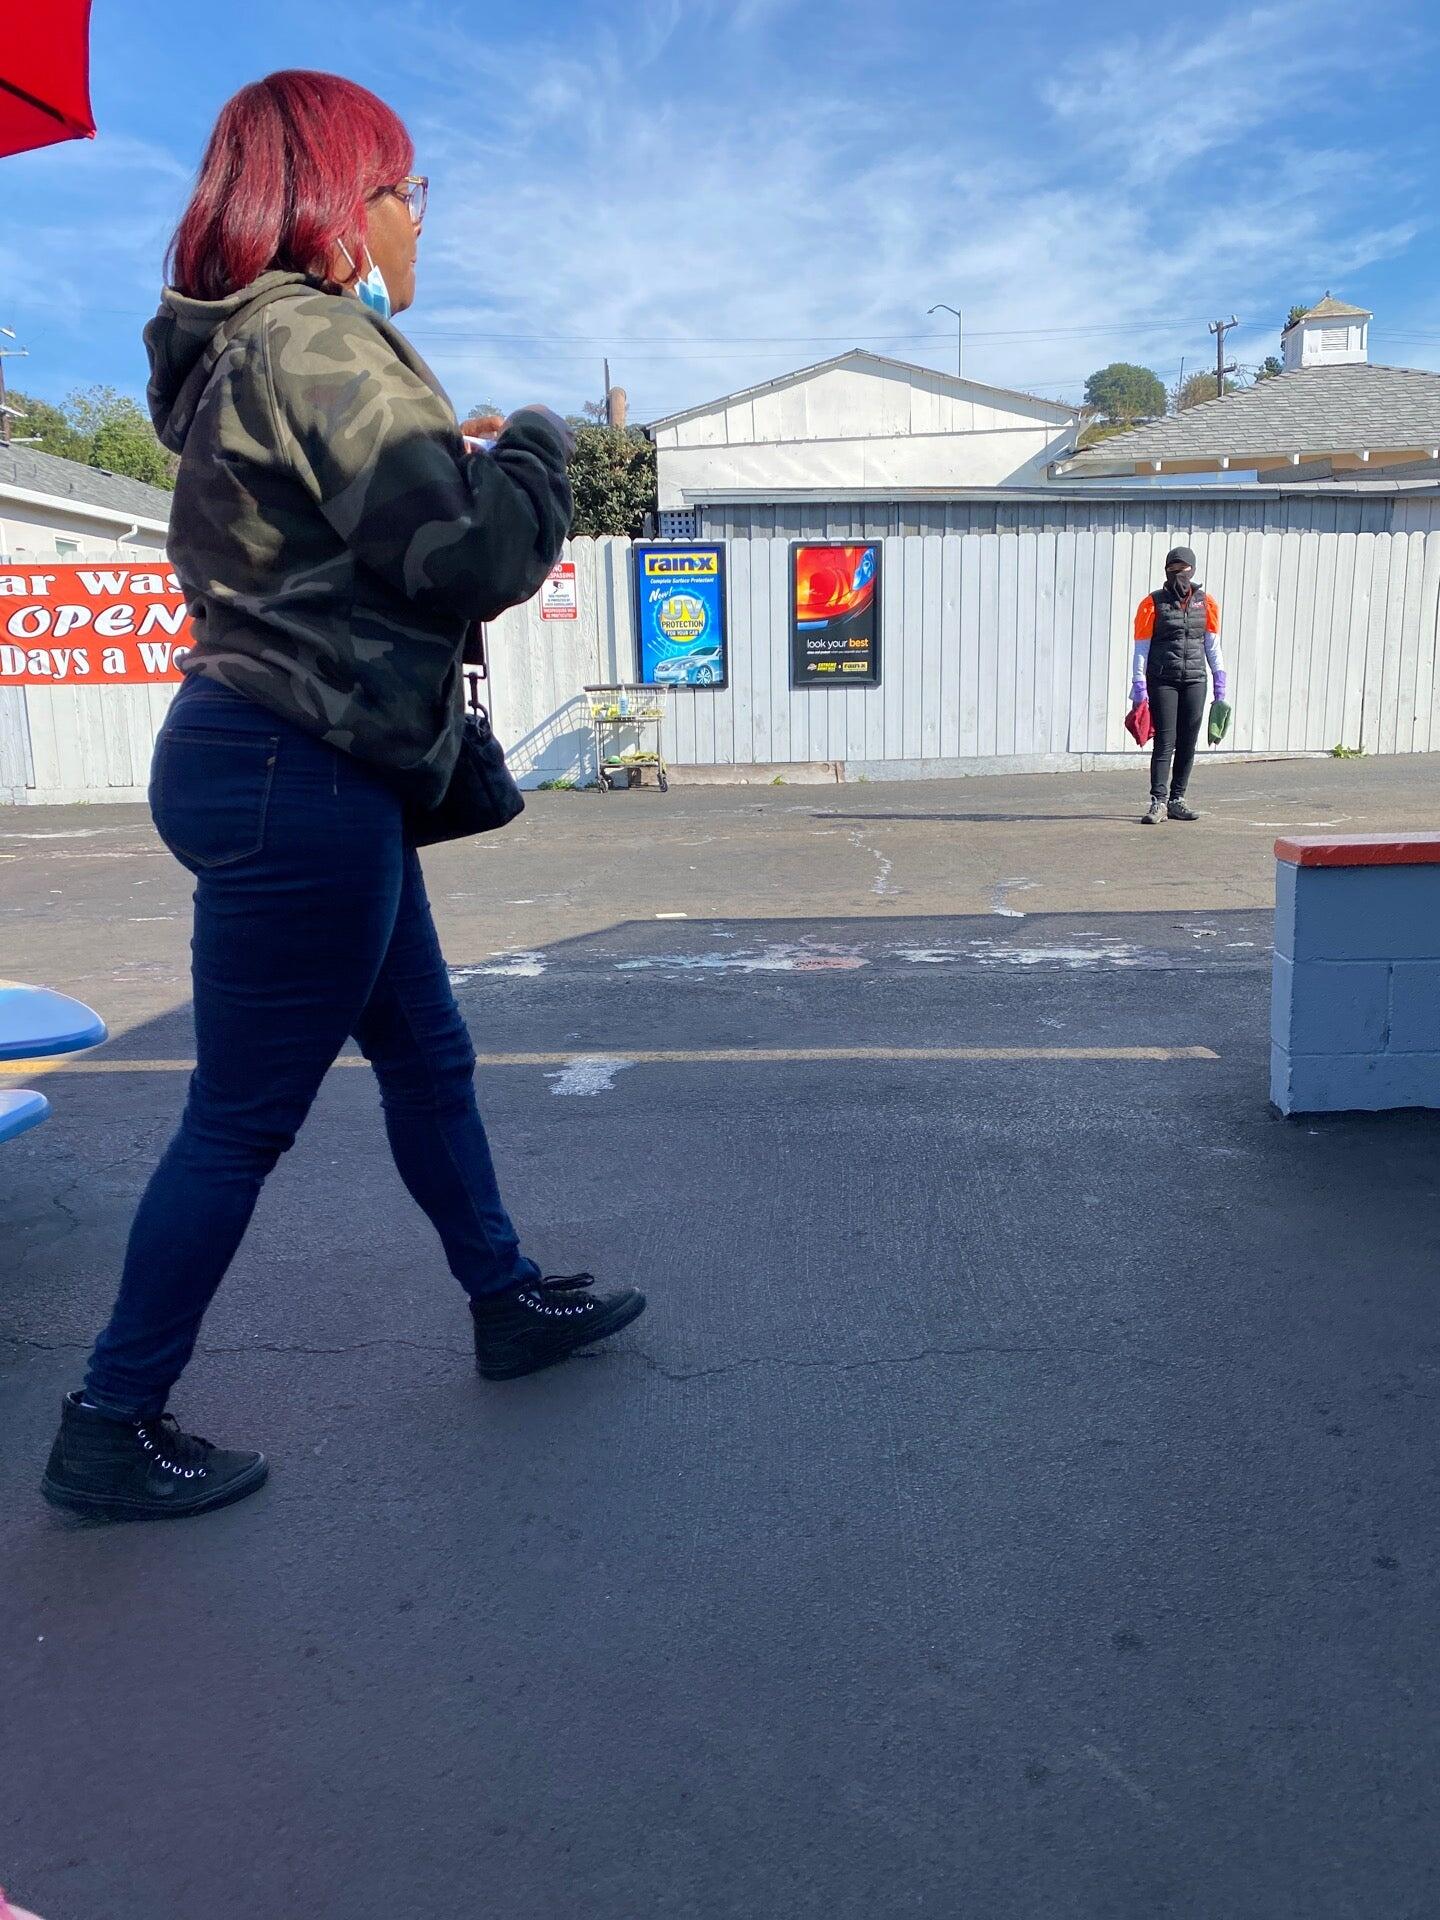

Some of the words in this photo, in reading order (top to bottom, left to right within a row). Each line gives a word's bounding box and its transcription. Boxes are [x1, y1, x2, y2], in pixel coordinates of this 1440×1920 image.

[0, 573, 56, 596] ar
[75, 570, 183, 595] Was
[649, 587, 673, 602] New!
[662, 599, 705, 620] UV
[661, 620, 704, 628] PROTECTION
[807, 639, 826, 648] look
[827, 640, 847, 649] your
[849, 638, 869, 647] best
[0, 644, 90, 679] Days
[102, 646, 127, 674] a
